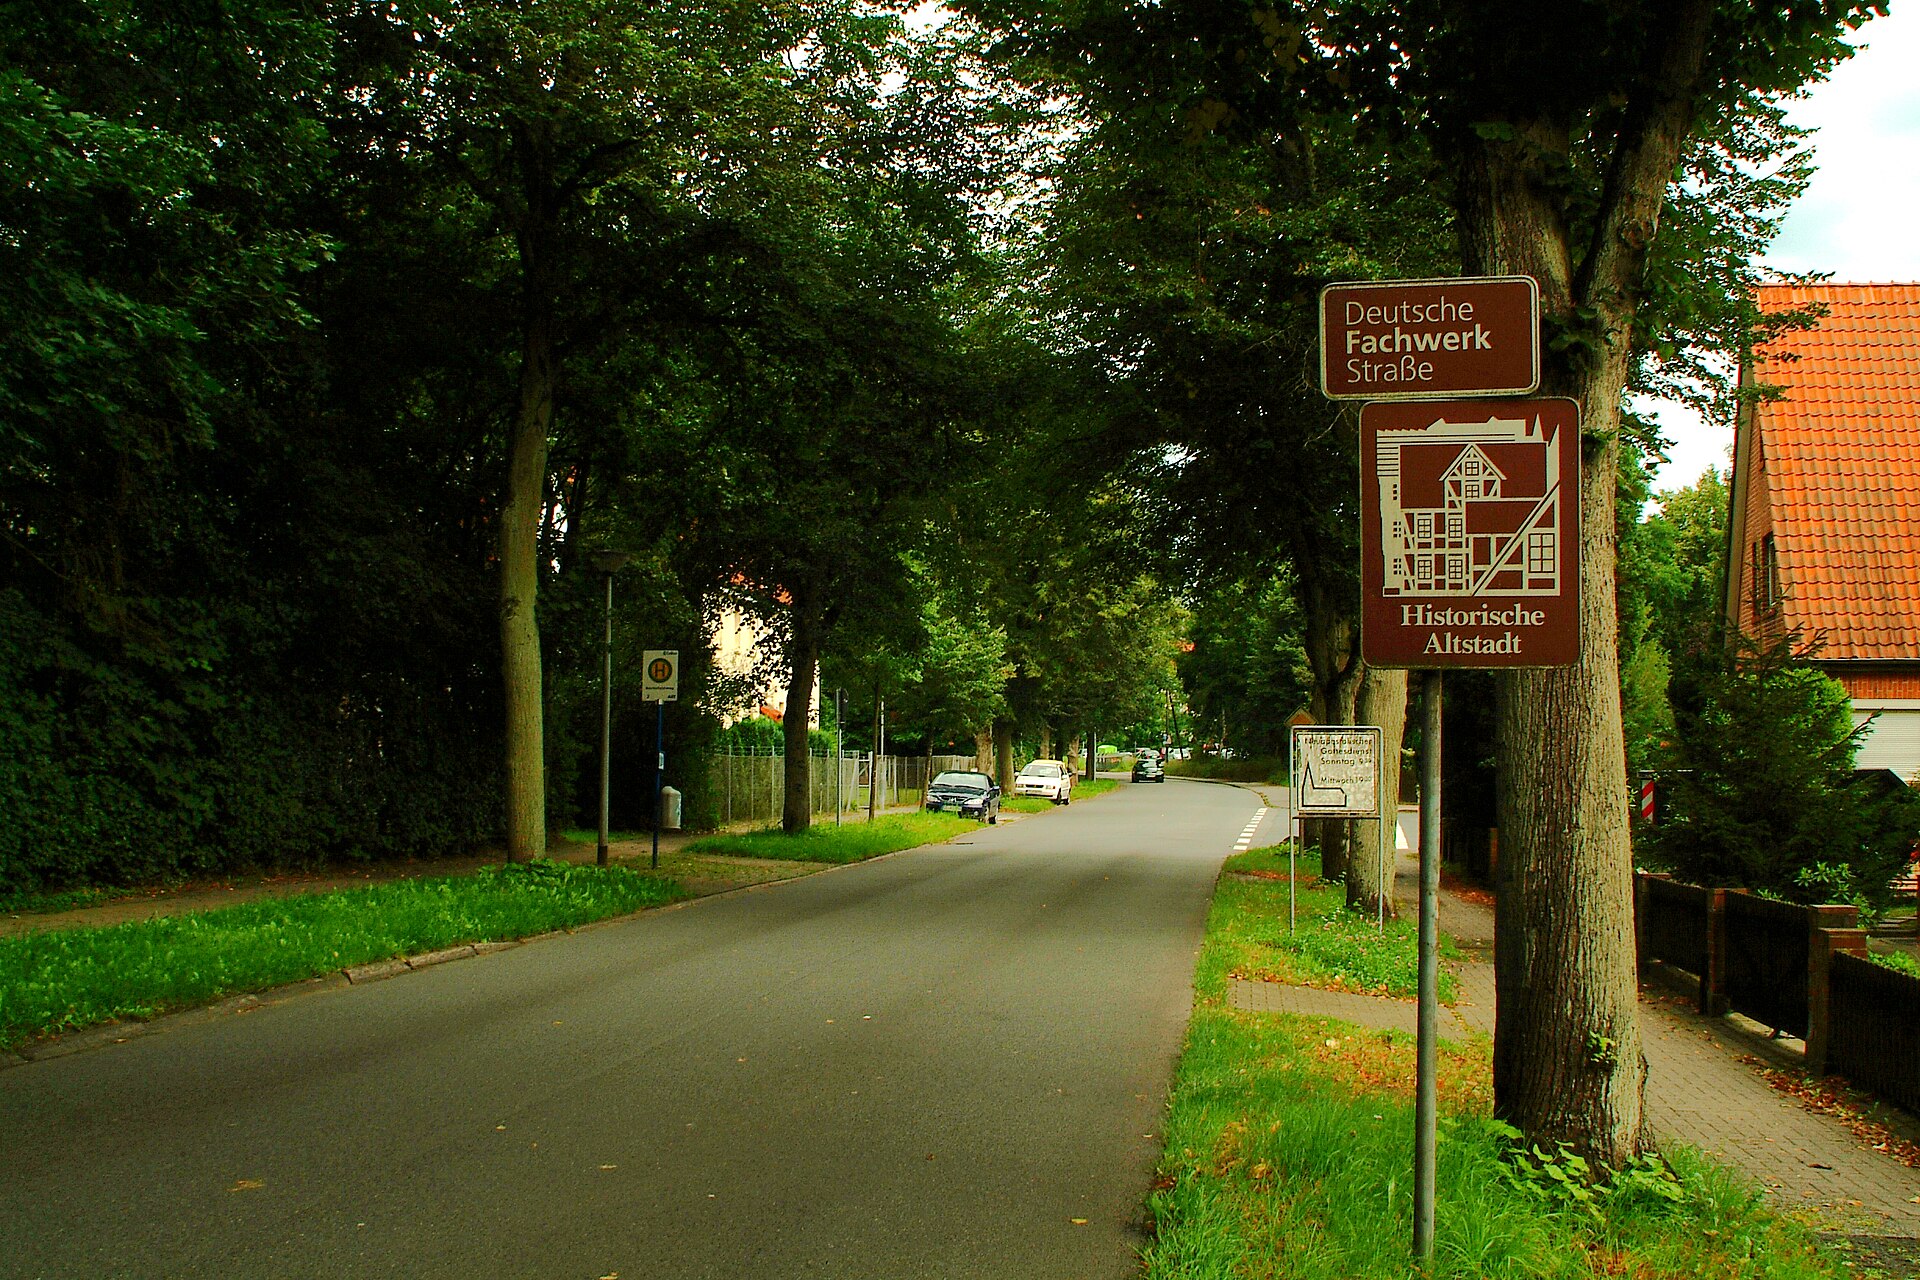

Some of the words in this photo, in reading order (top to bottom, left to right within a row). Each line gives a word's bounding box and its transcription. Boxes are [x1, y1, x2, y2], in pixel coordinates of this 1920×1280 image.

[1345, 295, 1474, 326] Deutsche
[1346, 323, 1492, 355] Fachwerk
[1347, 355, 1434, 384] Straße
[1400, 602, 1546, 627] Historische
[1422, 631, 1523, 655] Altstadt
[655, 663, 666, 677] H
[1320, 757, 1355, 767] Sonntag
